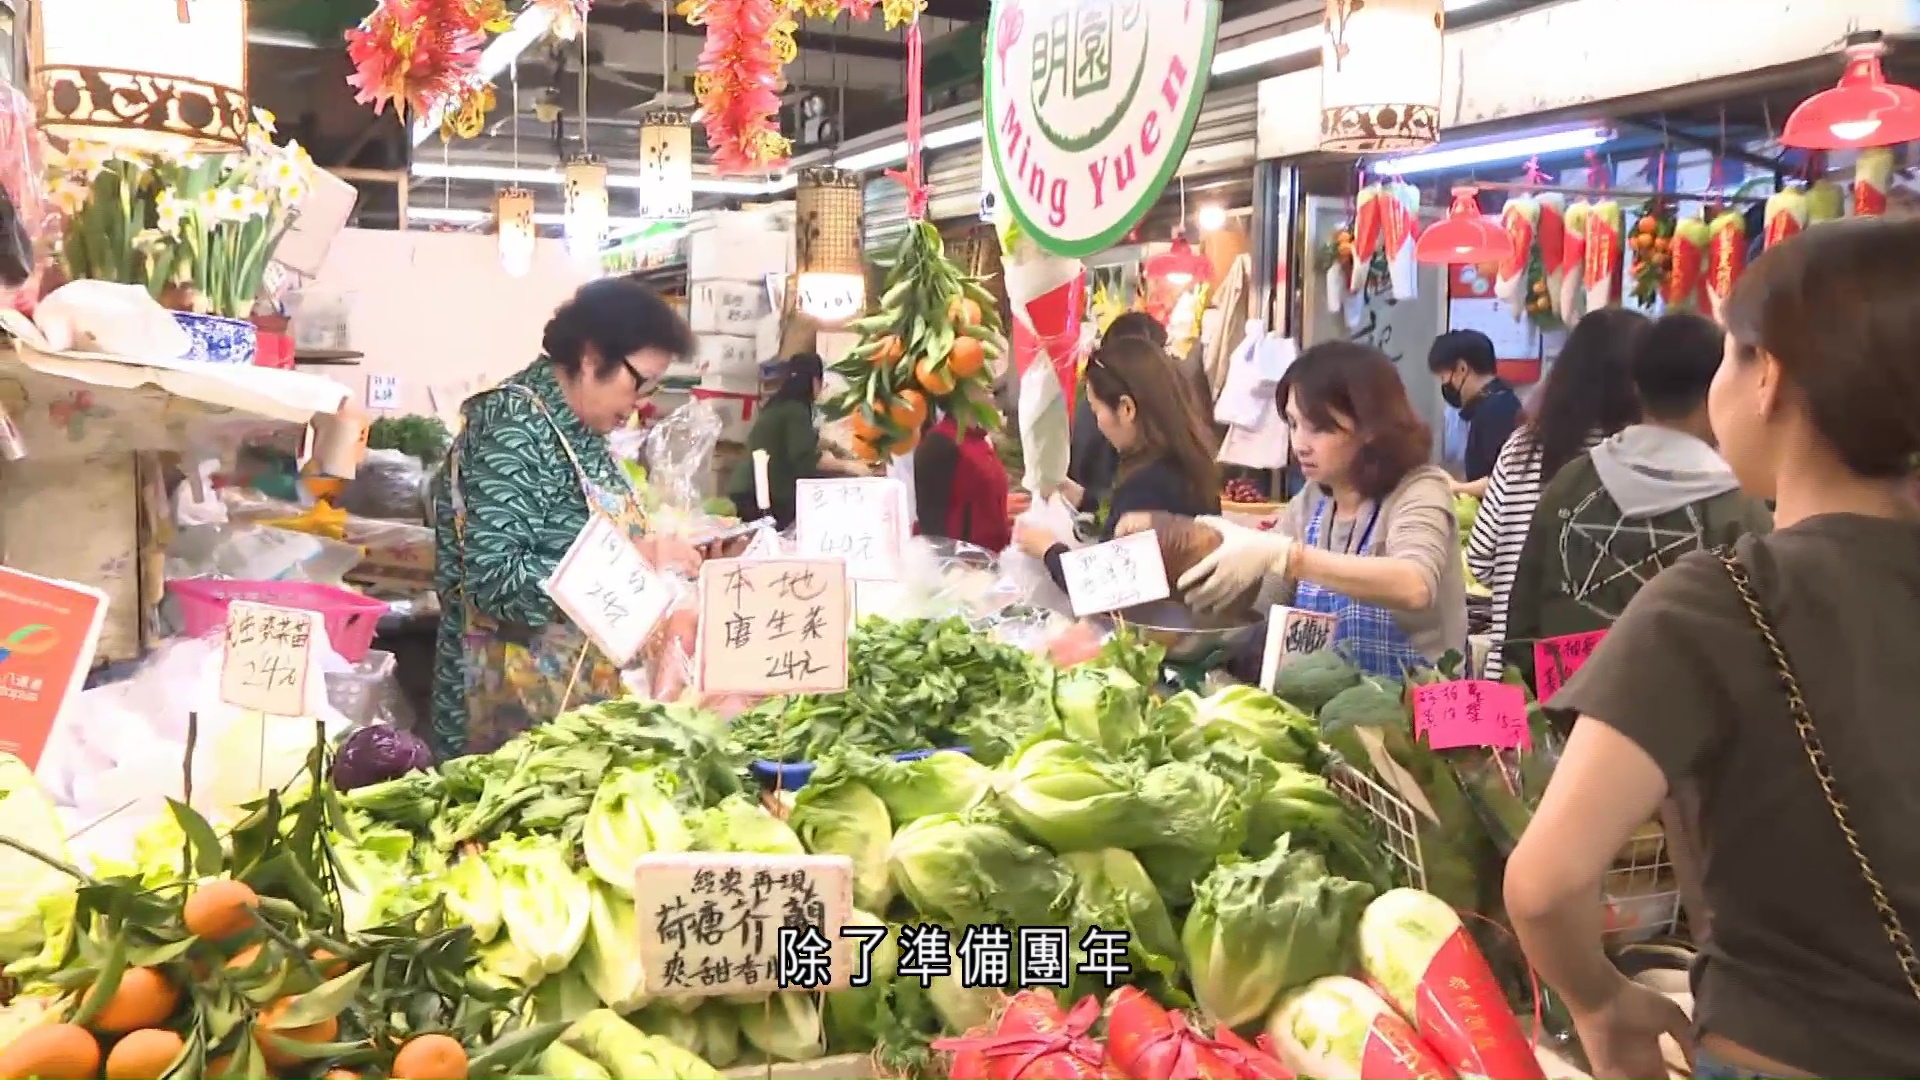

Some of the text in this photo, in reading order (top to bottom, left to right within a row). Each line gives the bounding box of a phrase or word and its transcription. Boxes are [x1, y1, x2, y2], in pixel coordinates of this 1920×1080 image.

[1030, 0, 1114, 108] 明園
[1000, 53, 1188, 228] Ming Yuen
[722, 563, 829, 610] 本地
[723, 605, 829, 649] 唐生菜
[764, 650, 831, 681] 24元
[690, 867, 807, 896] 經典再現
